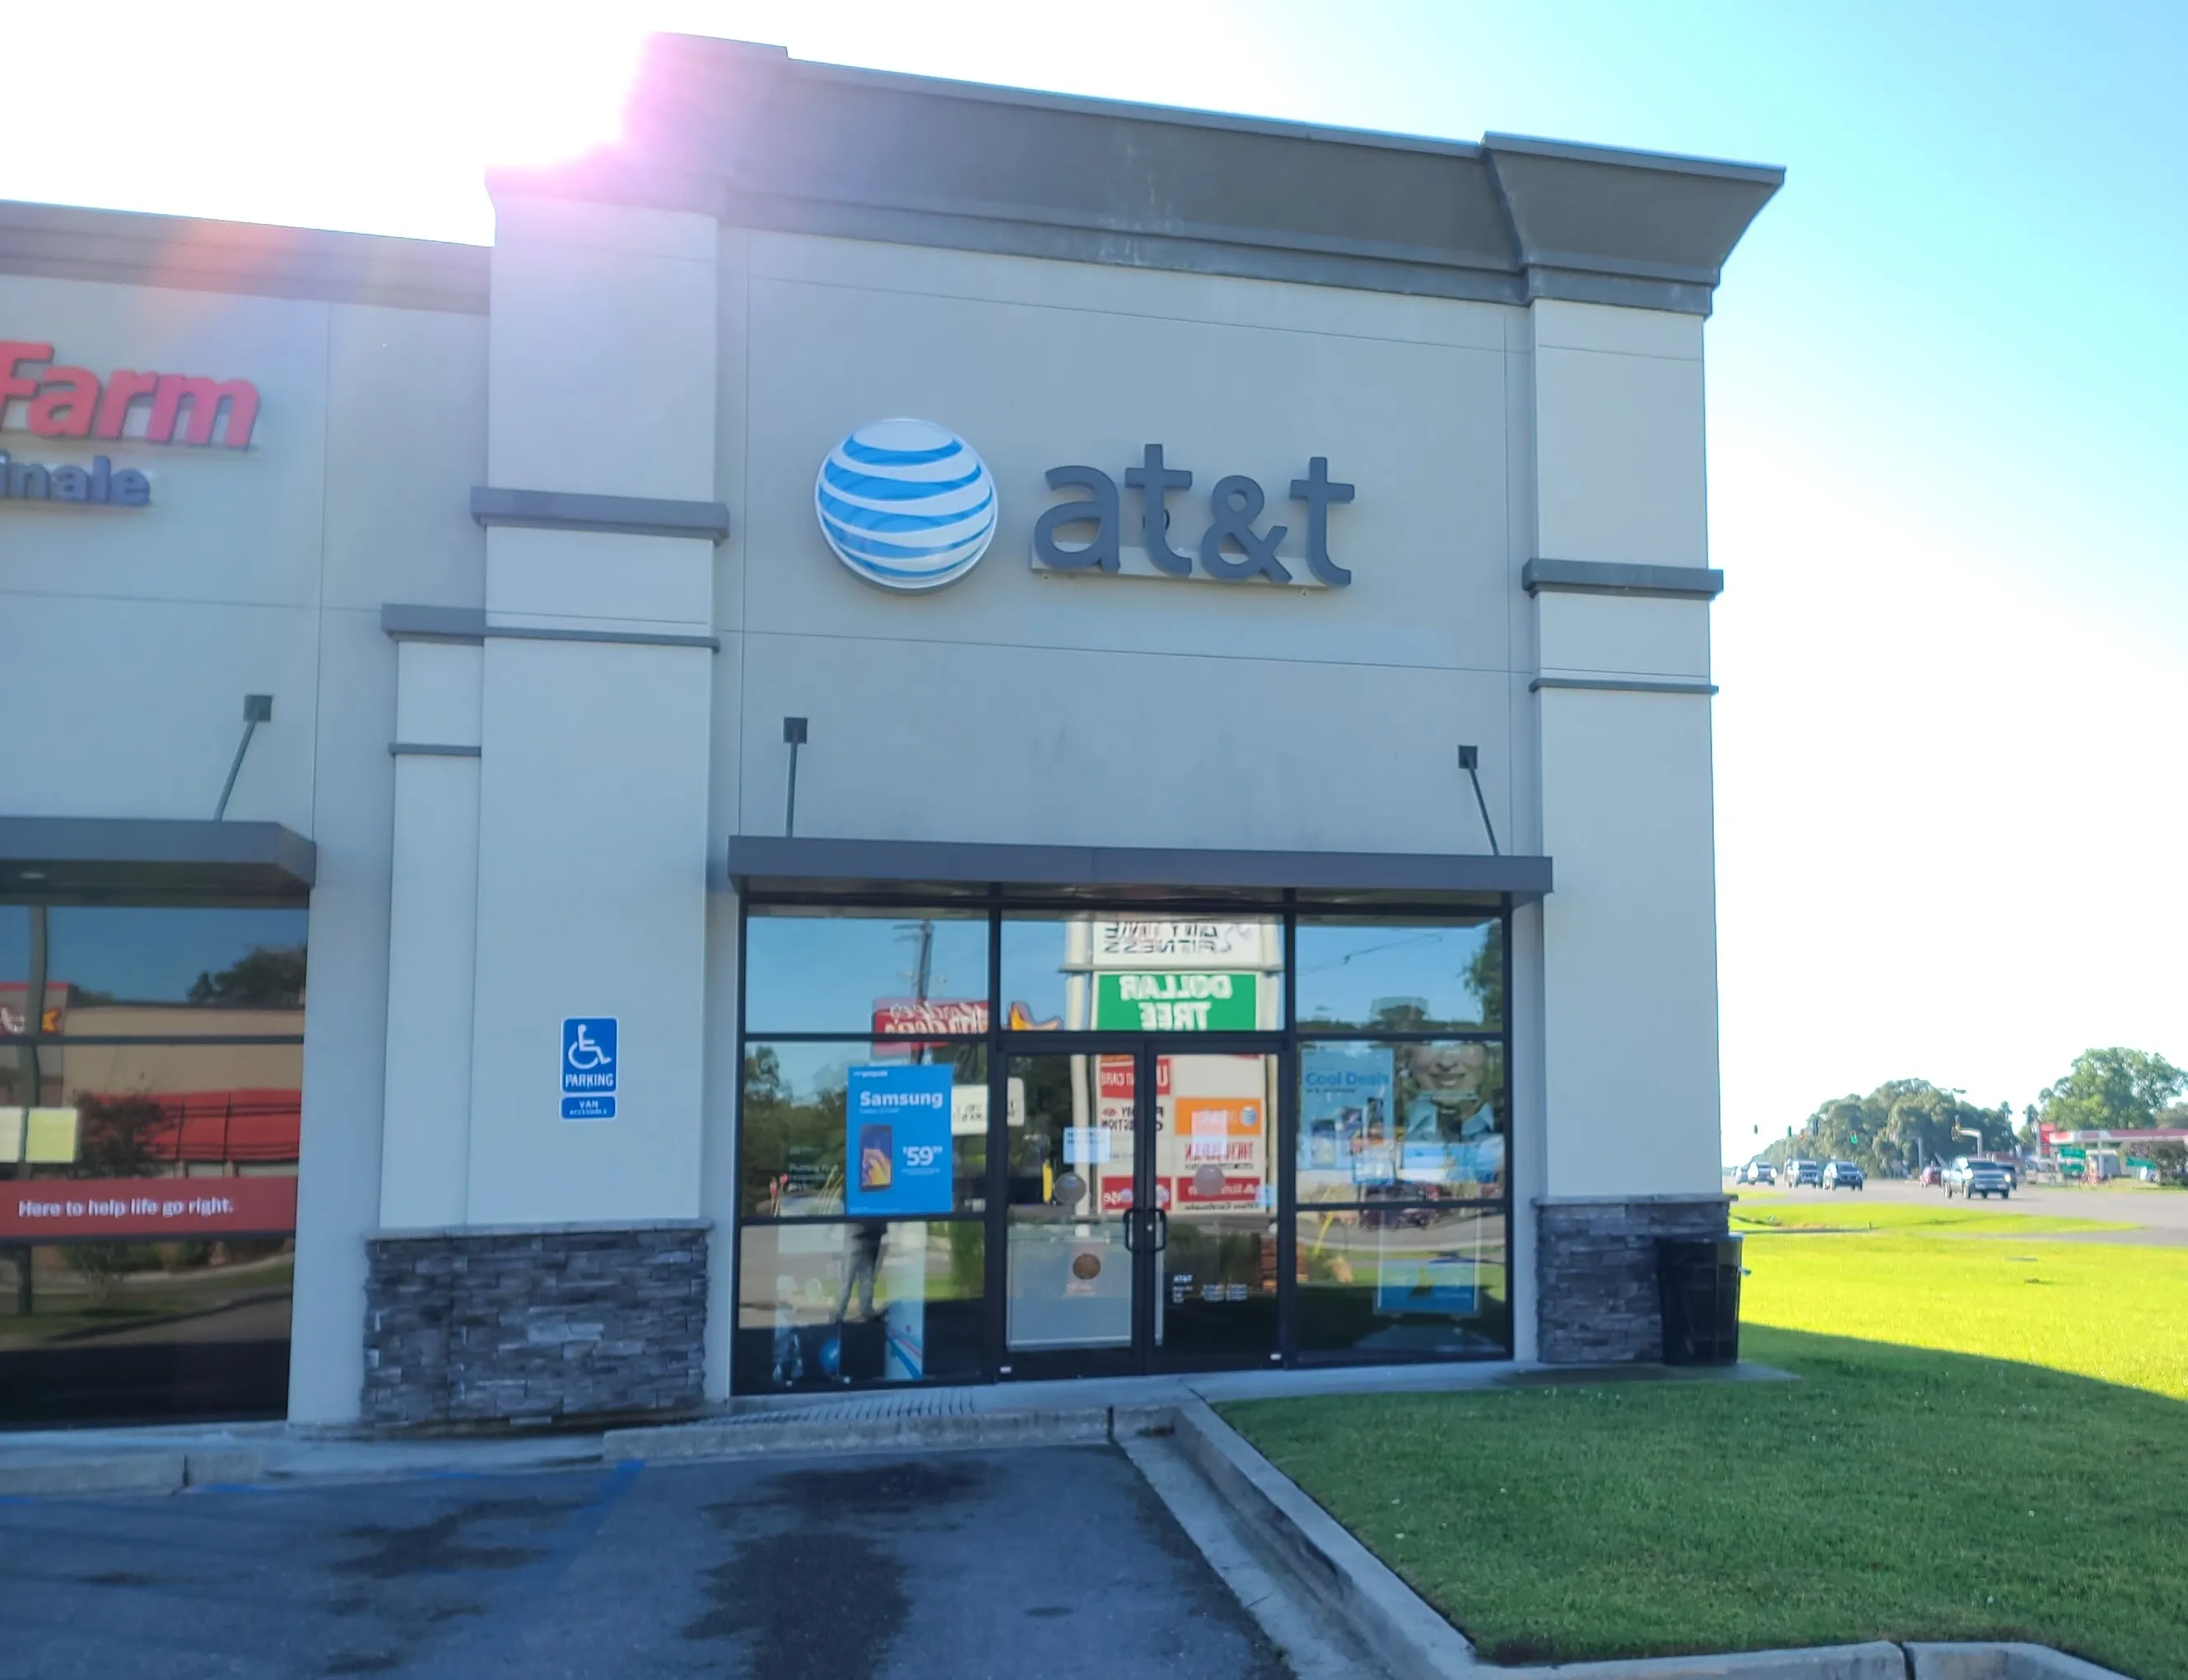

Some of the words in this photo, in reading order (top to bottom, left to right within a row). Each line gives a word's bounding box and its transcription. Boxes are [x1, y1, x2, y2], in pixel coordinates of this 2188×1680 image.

[0, 339, 261, 449] Farm
[1033, 444, 1355, 586] at&t
[565, 1073, 614, 1088] PARKING
[579, 1100, 598, 1108] VAN
[860, 1091, 943, 1110] Samsung
[18, 1199, 60, 1217] Here
[66, 1199, 83, 1217] to
[88, 1198, 125, 1218] help
[131, 1198, 157, 1215] life
[162, 1199, 184, 1217] go
[189, 1197, 233, 1216] right.
